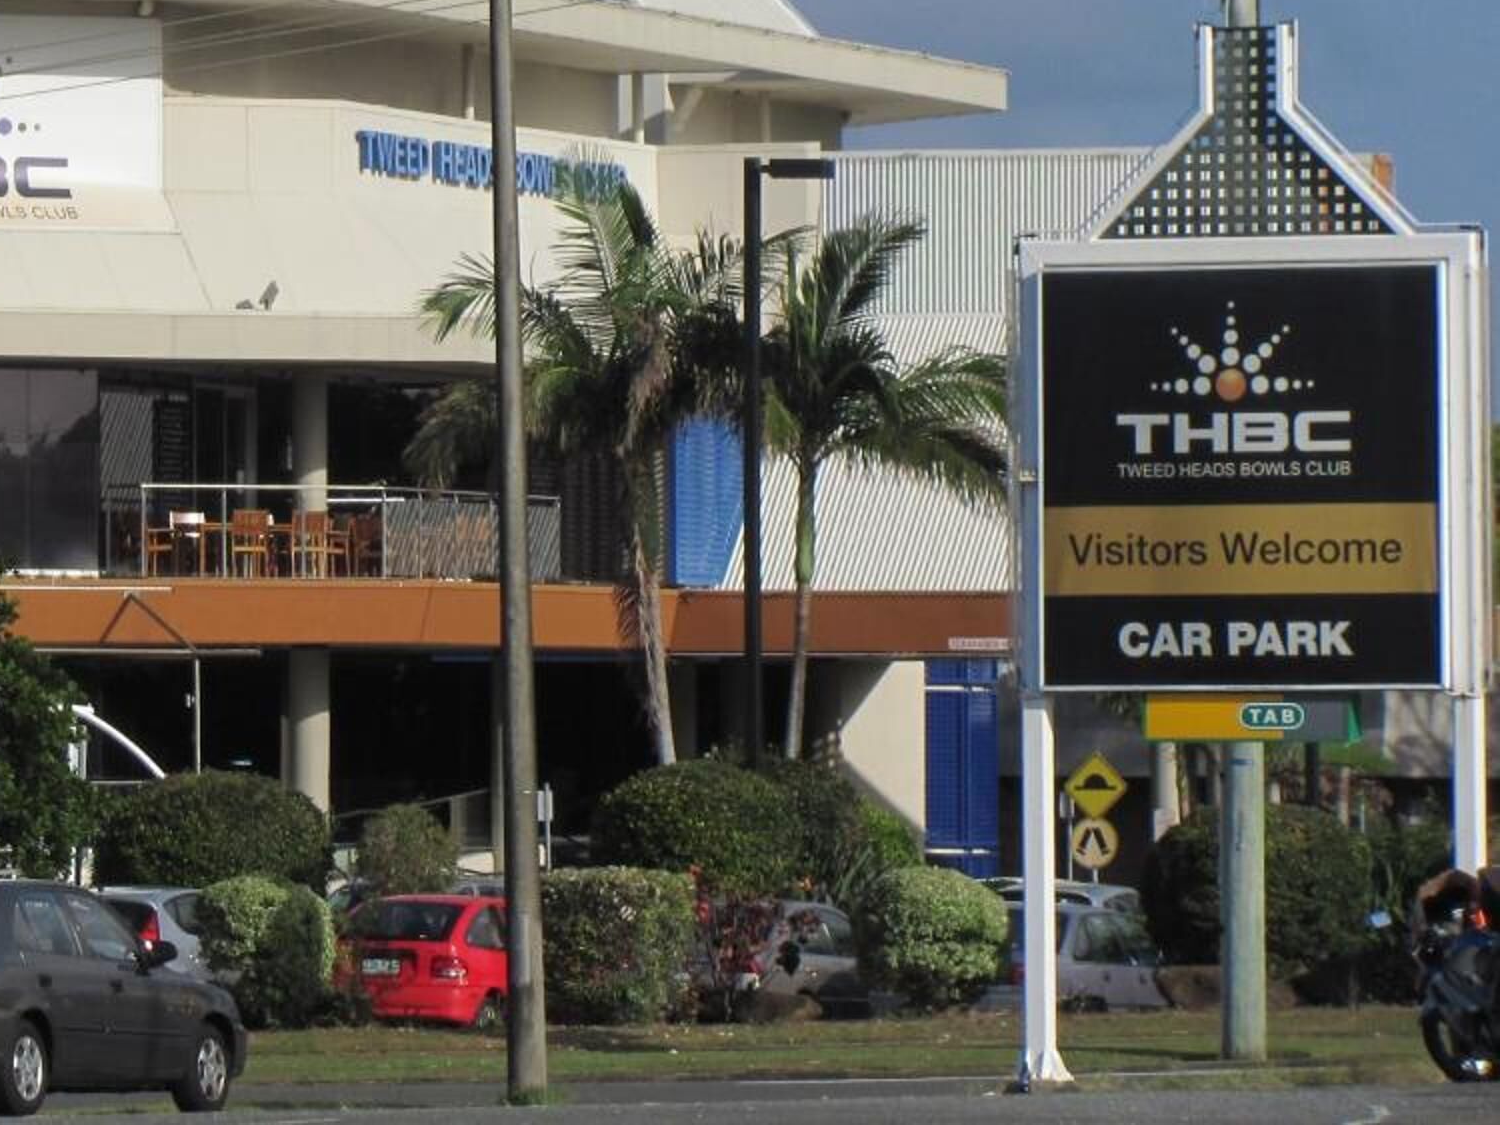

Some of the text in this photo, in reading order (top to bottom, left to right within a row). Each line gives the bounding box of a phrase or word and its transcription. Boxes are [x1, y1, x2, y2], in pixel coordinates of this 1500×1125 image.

[356, 131, 428, 180] TWEED
[432, 140, 493, 189] HEAD
[32, 206, 79, 220] CLUB
[1116, 411, 1352, 454] THBC
[1117, 460, 1351, 478] TWEED HEADS BOWLS CLUB
[1069, 532, 1402, 566] Visitors Welcome
[1118, 621, 1354, 658] CAR PARK
[1249, 707, 1296, 725] TAB
